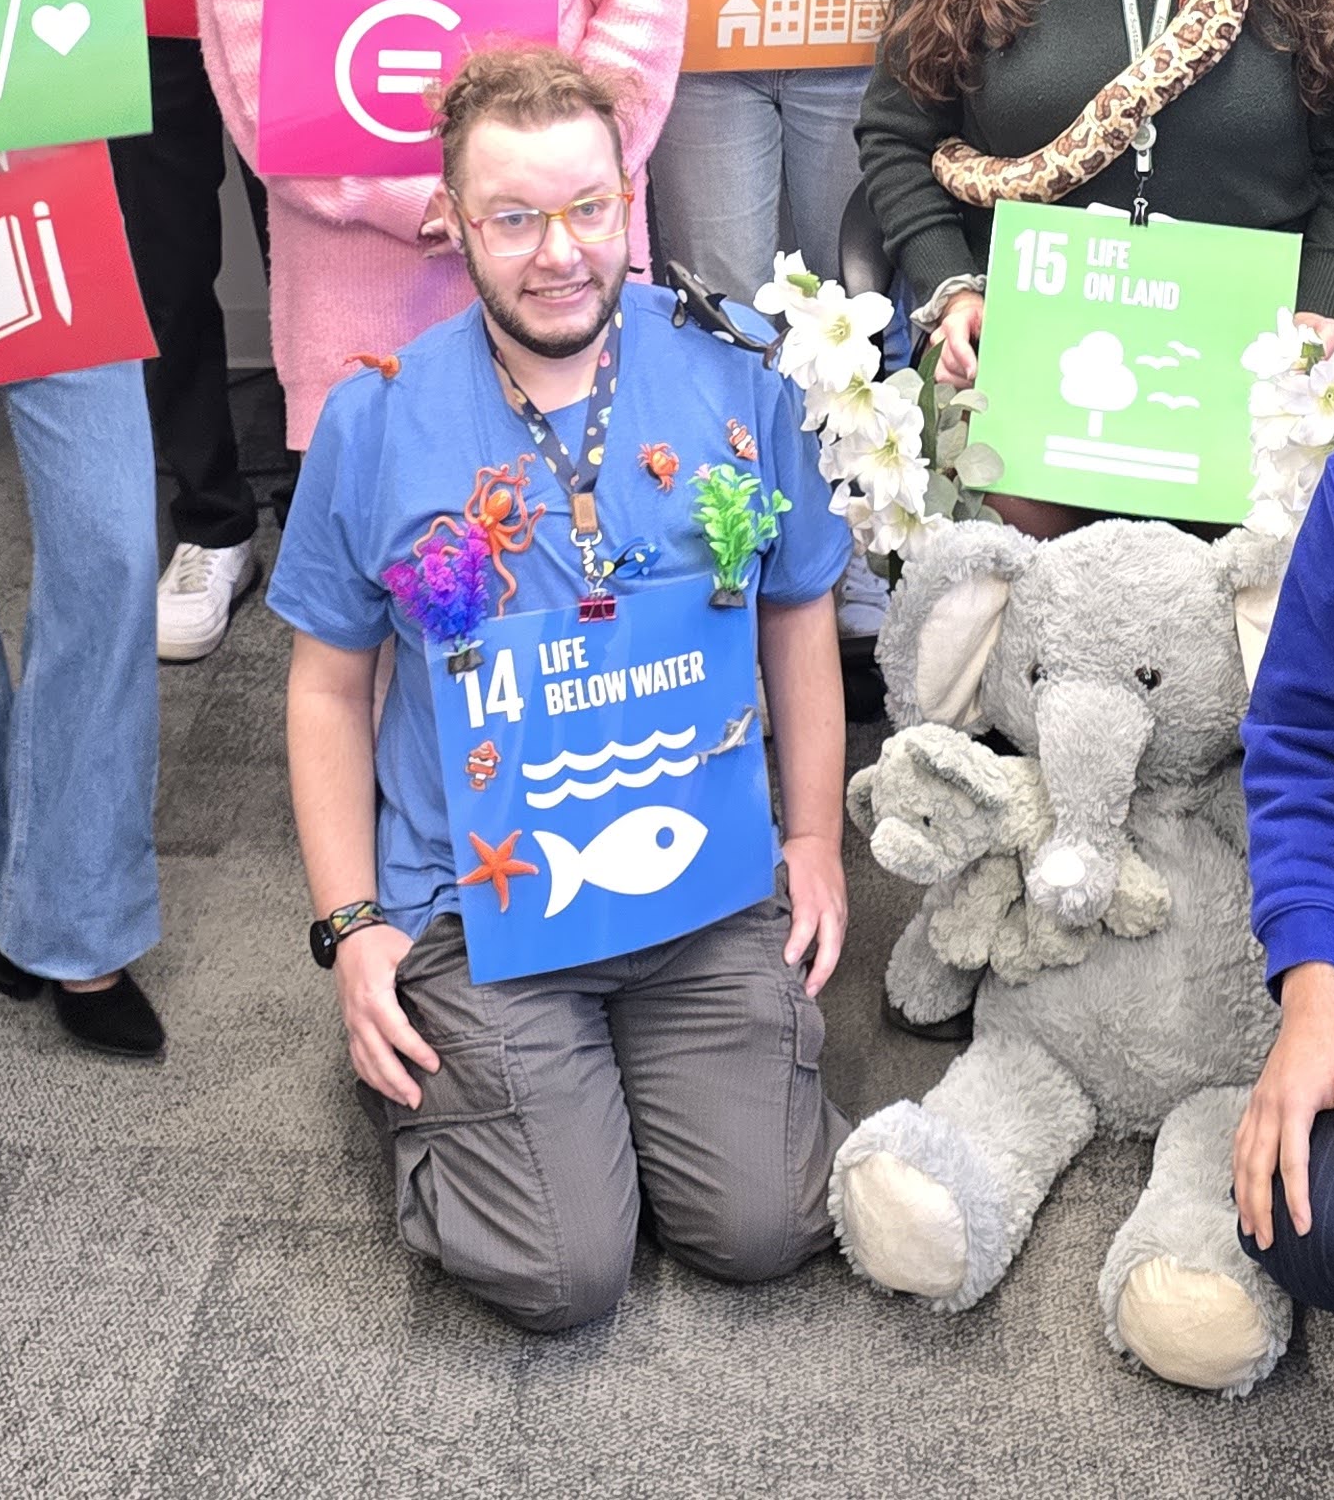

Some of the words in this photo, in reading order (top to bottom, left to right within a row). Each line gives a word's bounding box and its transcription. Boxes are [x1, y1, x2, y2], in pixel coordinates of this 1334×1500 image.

[1014, 229, 1069, 296] 15
[1087, 237, 1131, 270] LIFE
[1083, 272, 1115, 302] ON
[1121, 276, 1180, 311] LAND
[538, 636, 589, 676] LIFE
[455, 649, 525, 729] 14
[544, 669, 627, 716] BELOW
[629, 650, 706, 698] WATER
